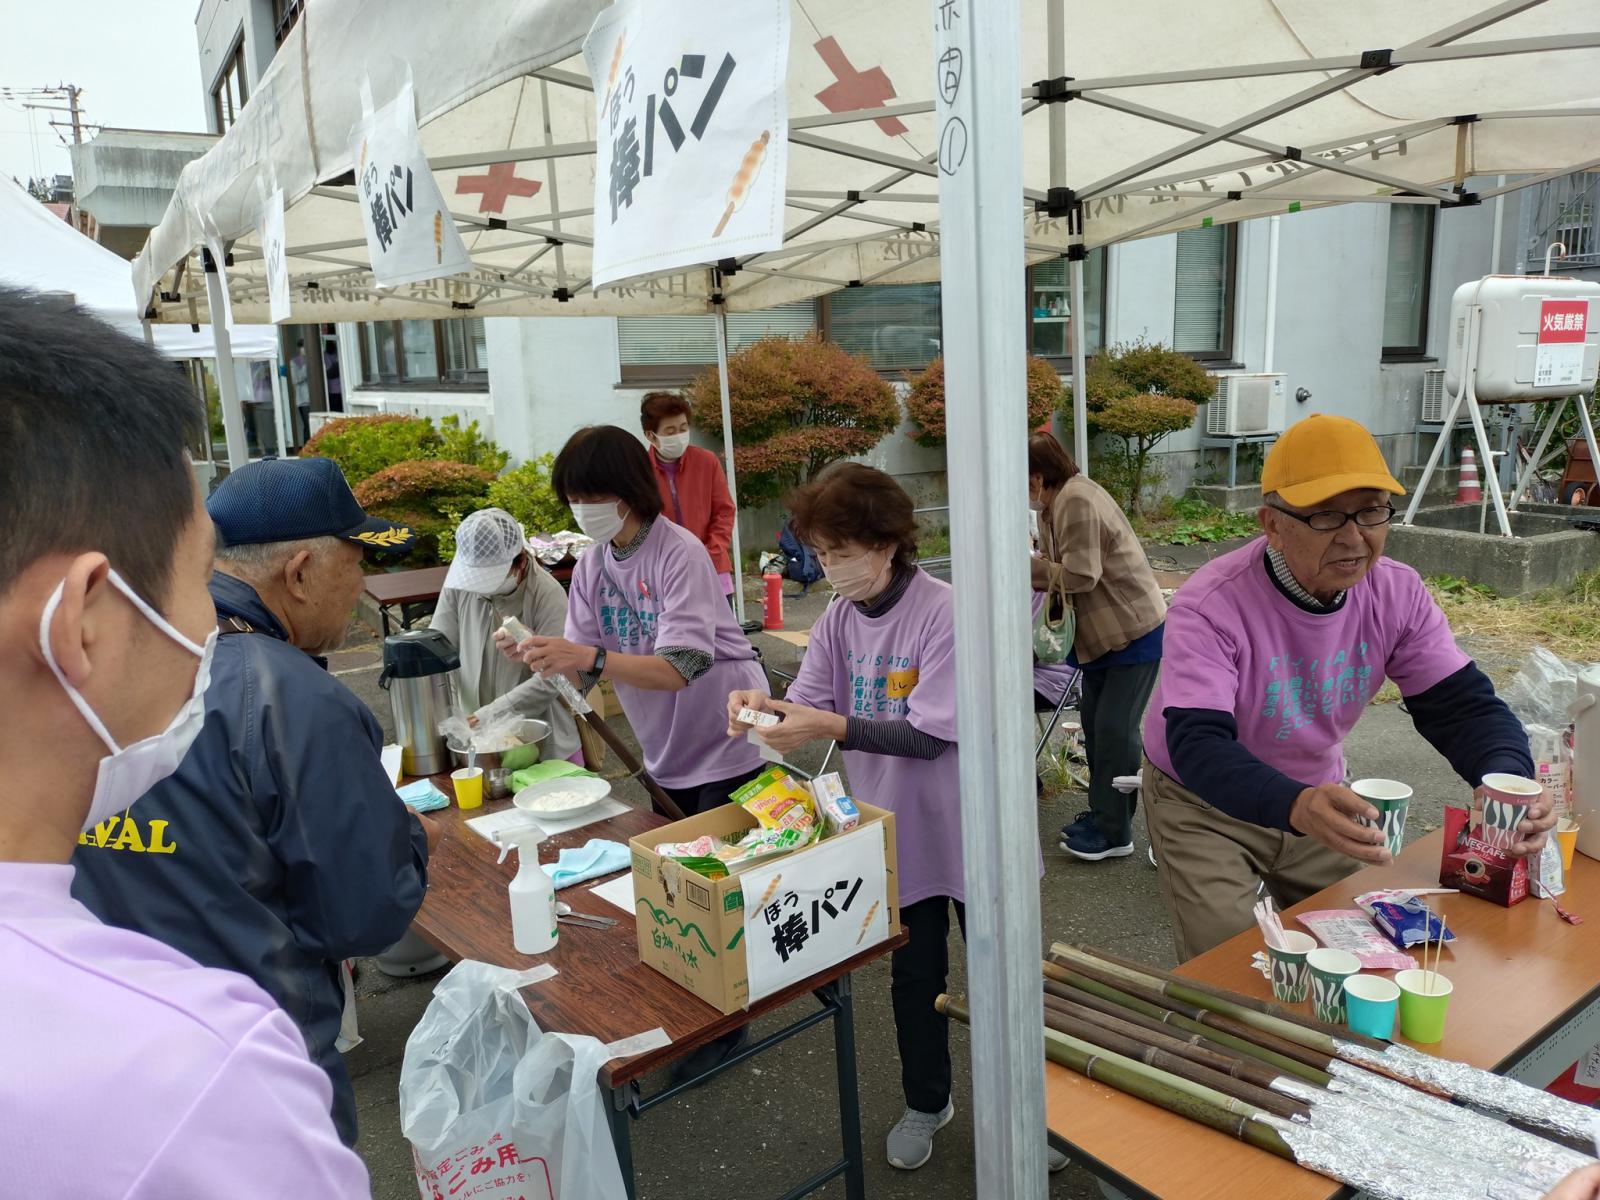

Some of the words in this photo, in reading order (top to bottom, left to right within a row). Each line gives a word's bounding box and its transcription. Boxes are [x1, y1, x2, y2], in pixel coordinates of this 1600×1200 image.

[609, 51, 737, 226] 棒パン
[370, 164, 413, 254] 棒パン
[1542, 312, 1585, 332] 火気厳禁
[764, 890, 799, 926] ぼう
[771, 876, 864, 964] 棒パン
